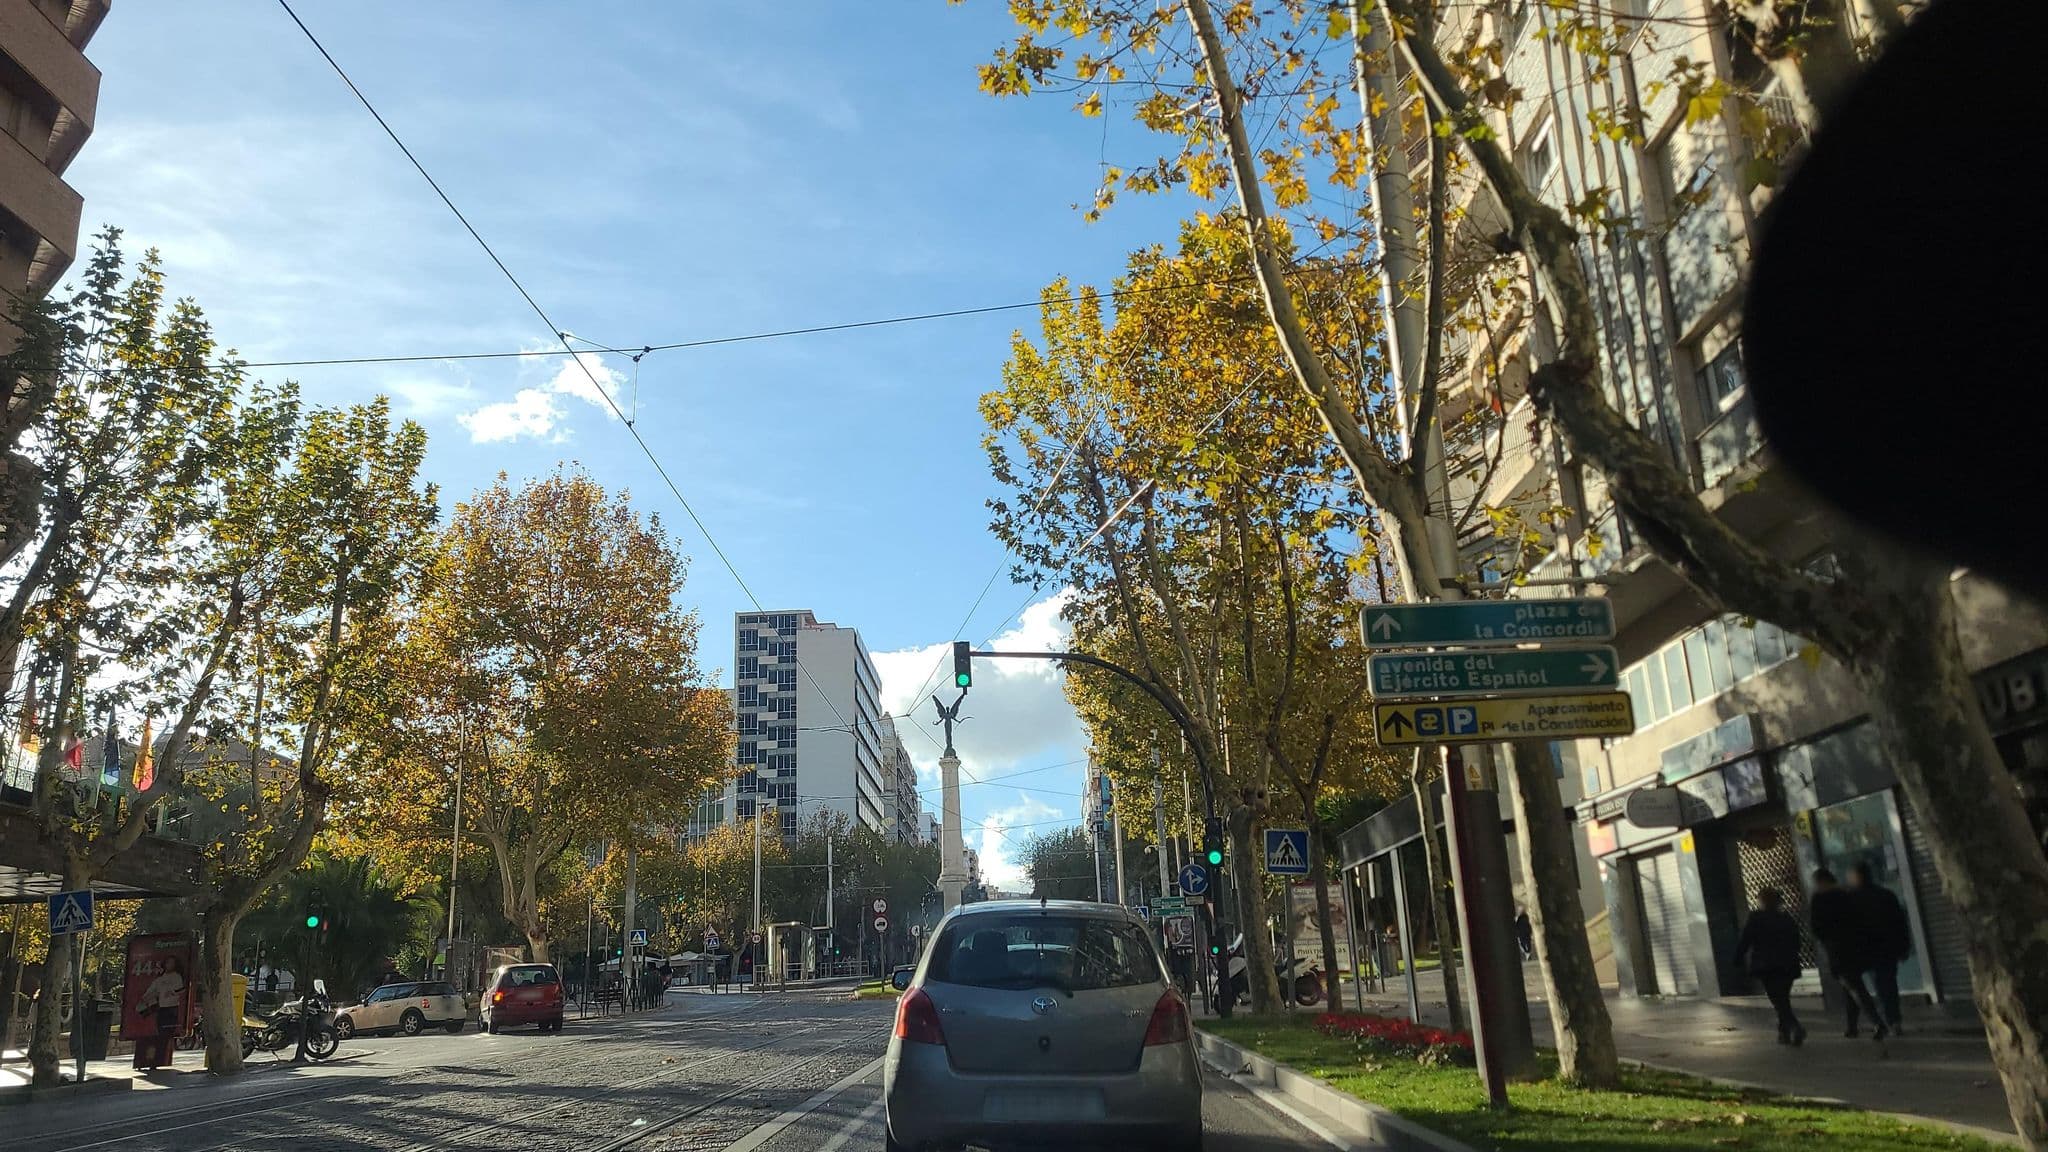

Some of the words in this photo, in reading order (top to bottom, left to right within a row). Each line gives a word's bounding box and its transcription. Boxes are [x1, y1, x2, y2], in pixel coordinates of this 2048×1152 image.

[1475, 623, 1494, 640] la
[1379, 656, 1455, 674] avenida
[1464, 655, 1495, 670] del
[1381, 671, 1460, 692] Ejército
[1468, 668, 1549, 689] Español
[1528, 701, 1625, 719] Aparcamiento
[1452, 708, 1473, 734] P
[1521, 719, 1536, 732] la
[1538, 715, 1629, 731] Constitución
